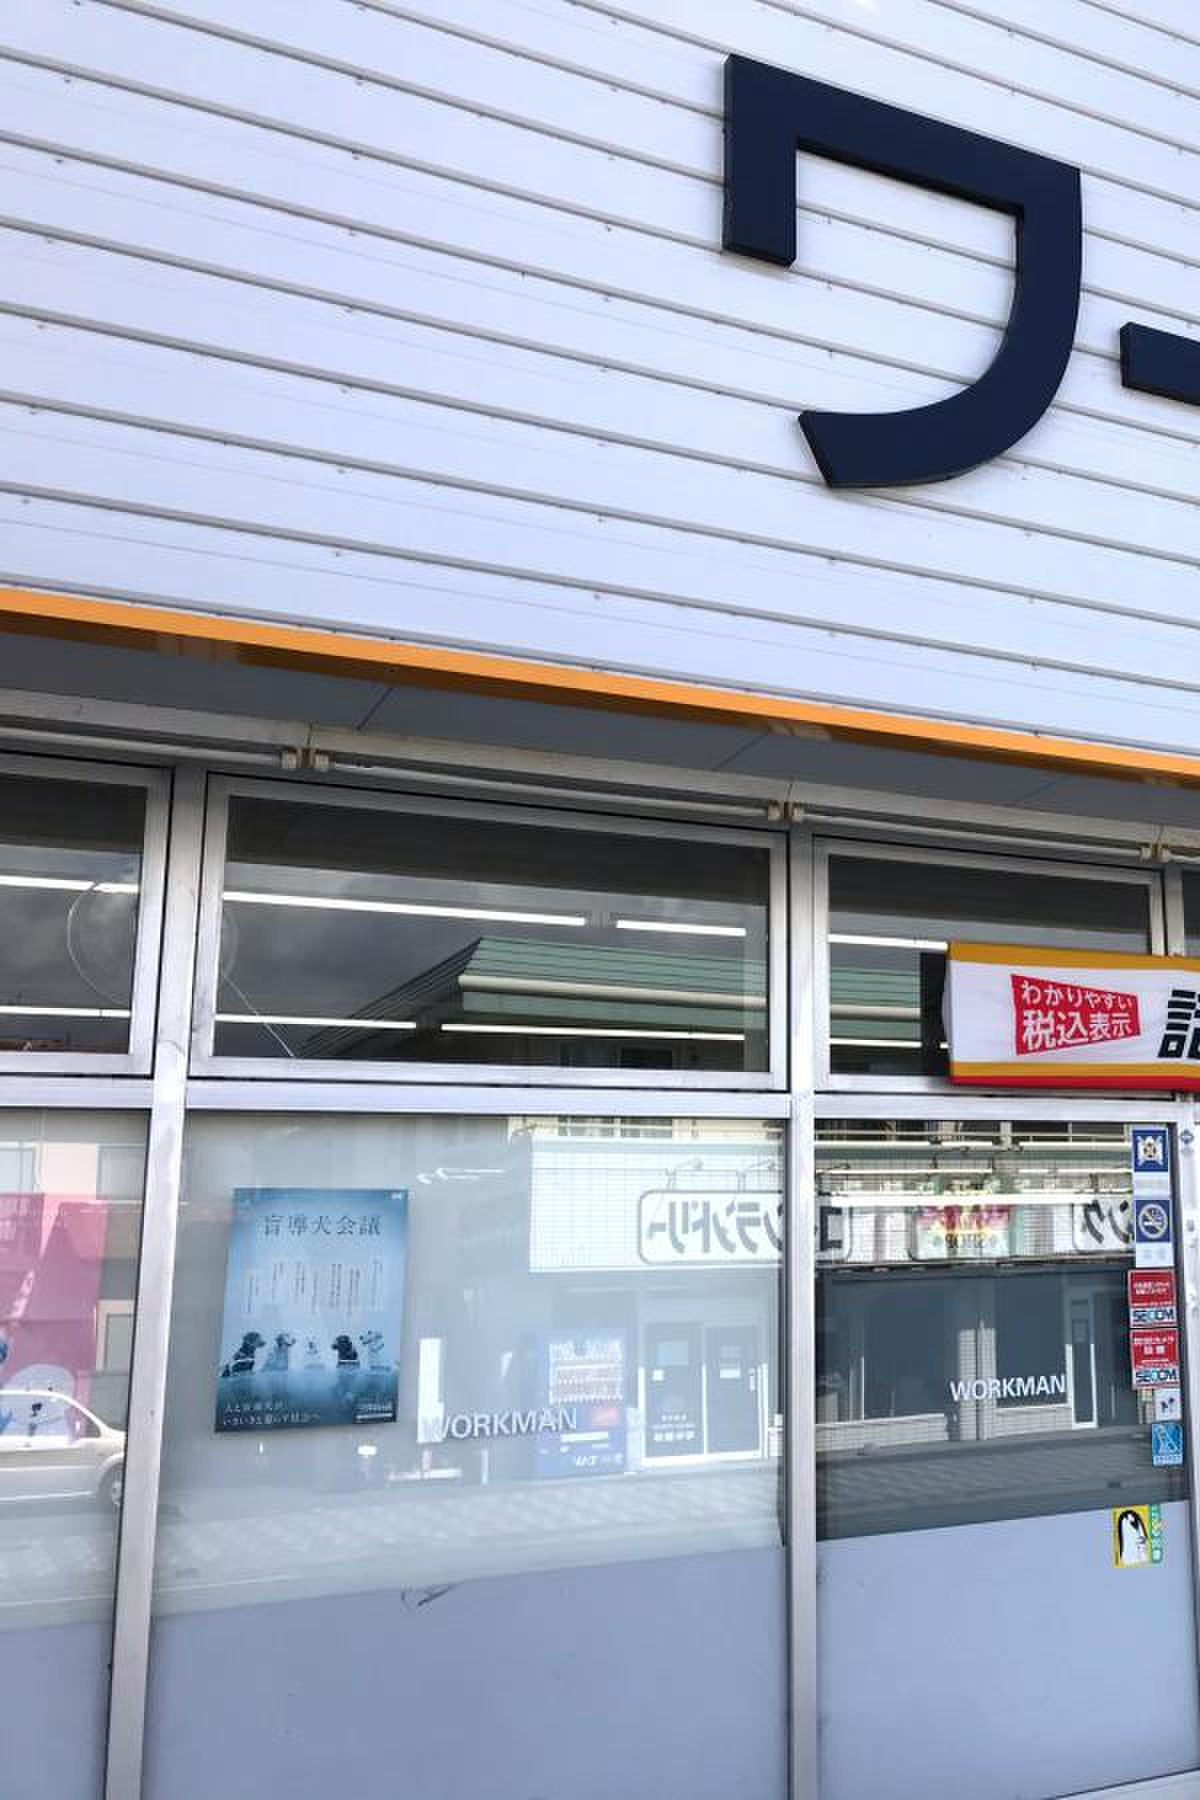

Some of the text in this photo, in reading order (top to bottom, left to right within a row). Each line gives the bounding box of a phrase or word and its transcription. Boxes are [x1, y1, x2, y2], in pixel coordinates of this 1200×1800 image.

[1021, 979, 1133, 1010] わかりやすい
[1023, 1008, 1133, 1051] 税込表示
[264, 1213, 382, 1237] 盲導犬会議
[1132, 1308, 1175, 1323] SECOM
[1135, 1368, 1177, 1383] SECOM
[949, 1375, 1065, 1402] WORKMAN
